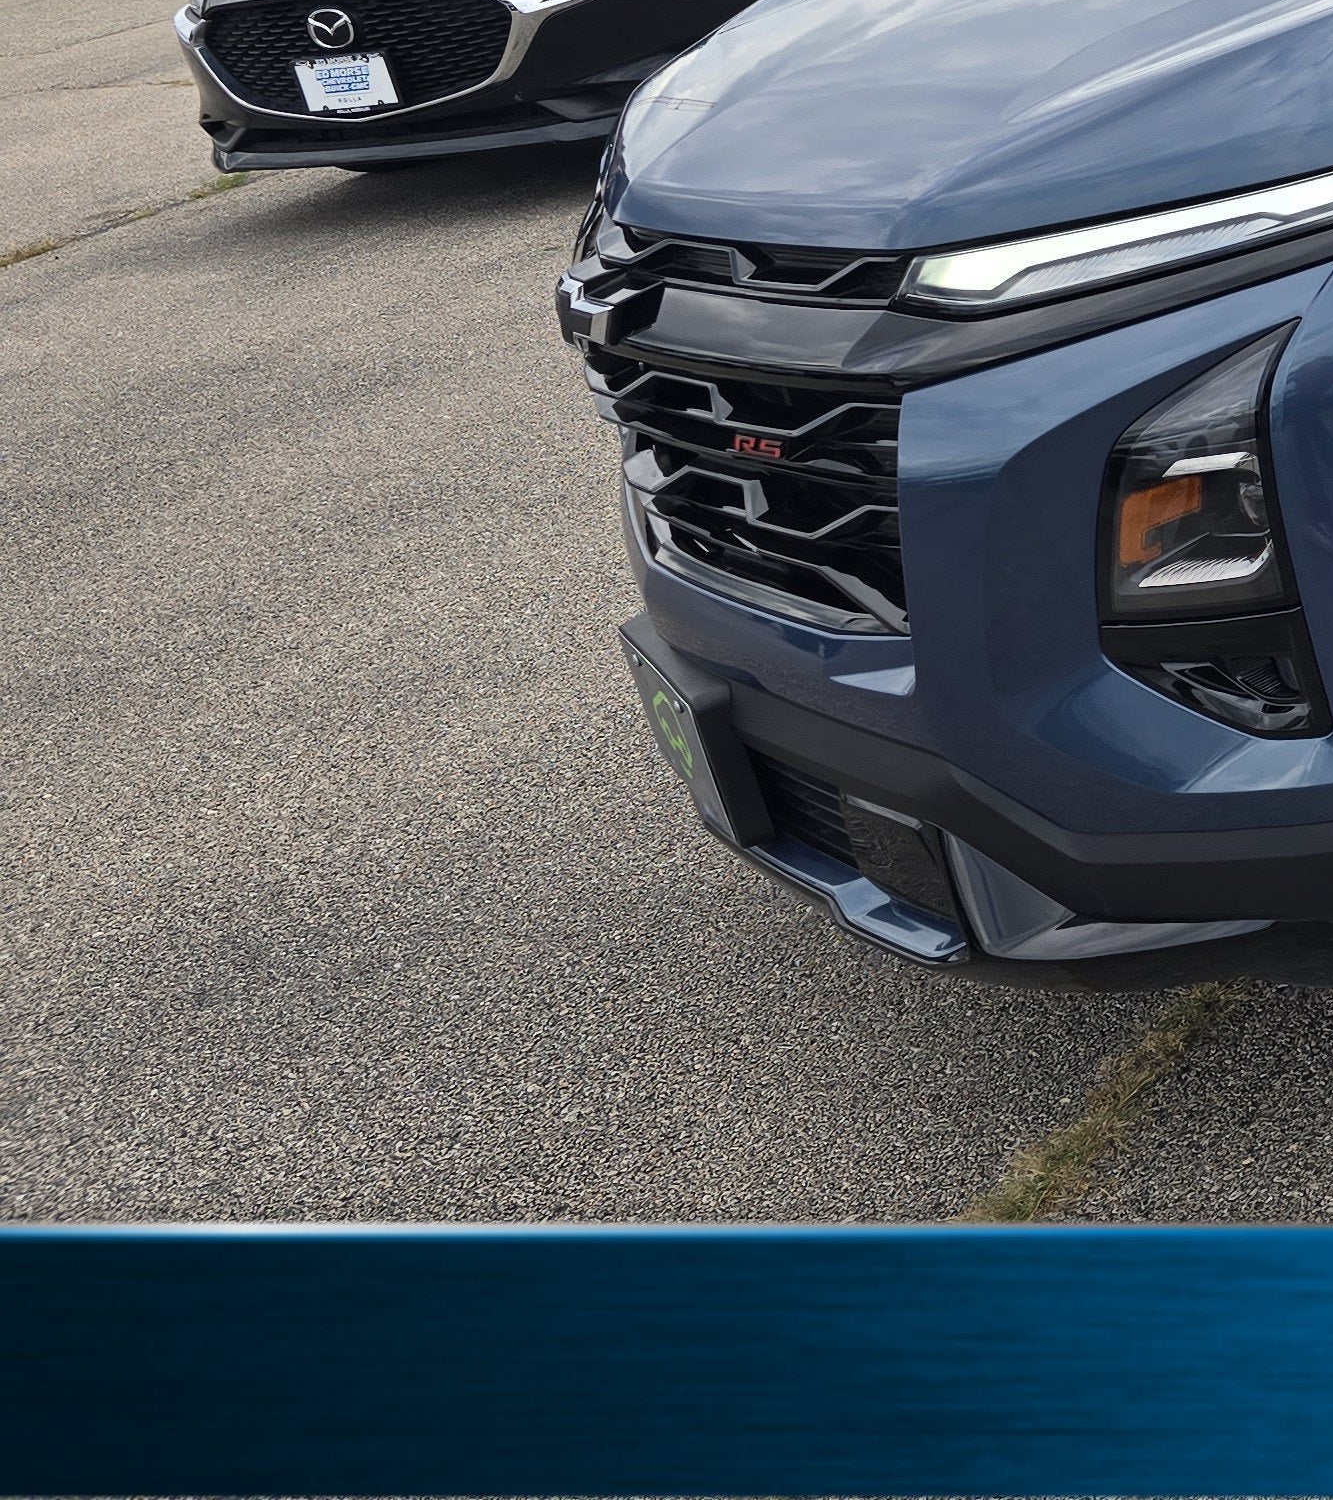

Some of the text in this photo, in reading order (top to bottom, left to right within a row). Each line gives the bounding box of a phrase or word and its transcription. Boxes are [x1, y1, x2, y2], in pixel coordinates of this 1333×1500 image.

[315, 65, 369, 80] ED MORSE
[734, 433, 783, 459] RS
